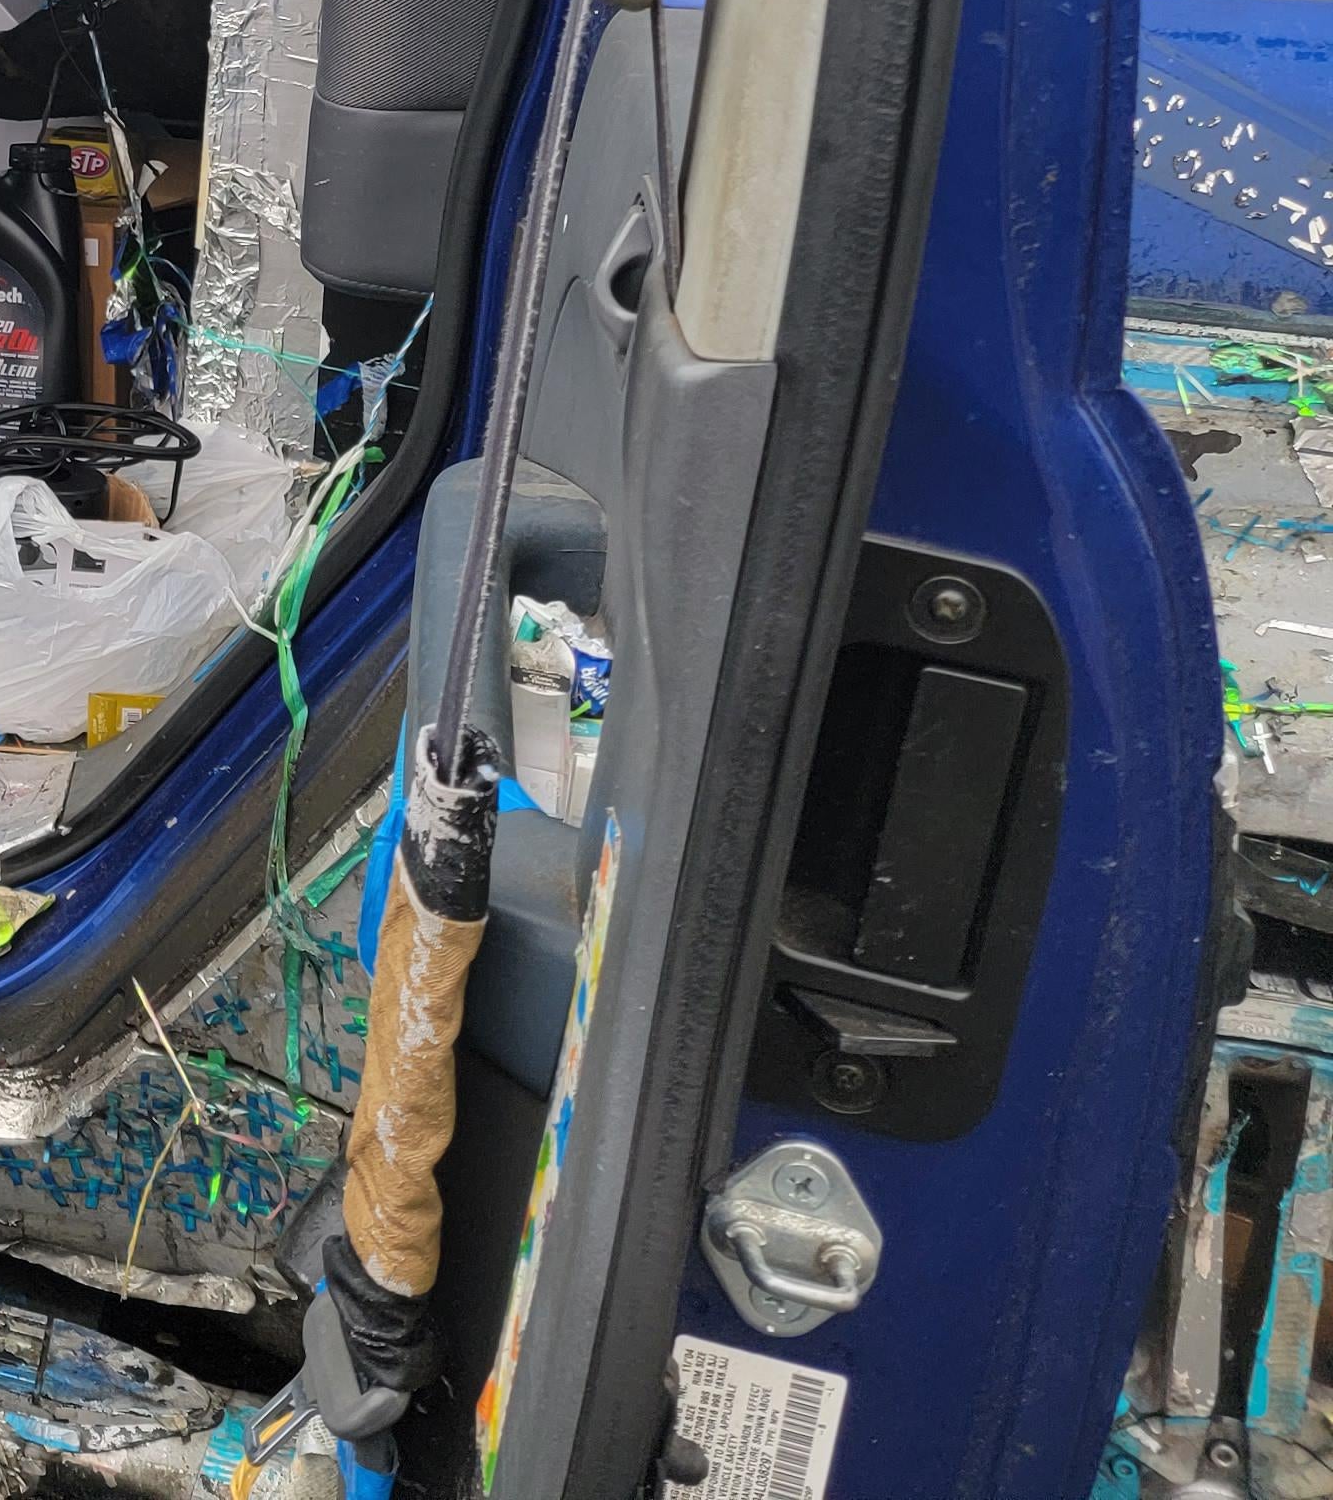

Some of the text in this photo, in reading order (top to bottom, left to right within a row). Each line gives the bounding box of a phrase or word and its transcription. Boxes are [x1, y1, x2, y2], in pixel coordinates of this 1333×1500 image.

[71, 150, 105, 173] STP
[695, 1350, 707, 1368] SIZE
[685, 1404, 697, 1421] SIZE
[719, 1384, 738, 1431] APPLICABLE
[759, 1388, 772, 1414] ABOVE
[769, 1409, 780, 1425] MPV
[718, 1433, 729, 1447] ALL
[729, 1383, 761, 1500] ENTION STANDARDS IN EFFECT
[753, 1415, 767, 1445] SHOWN
[714, 1448, 725, 1459] TO
[718, 1434, 738, 1497] VEHICLE SAFETY
